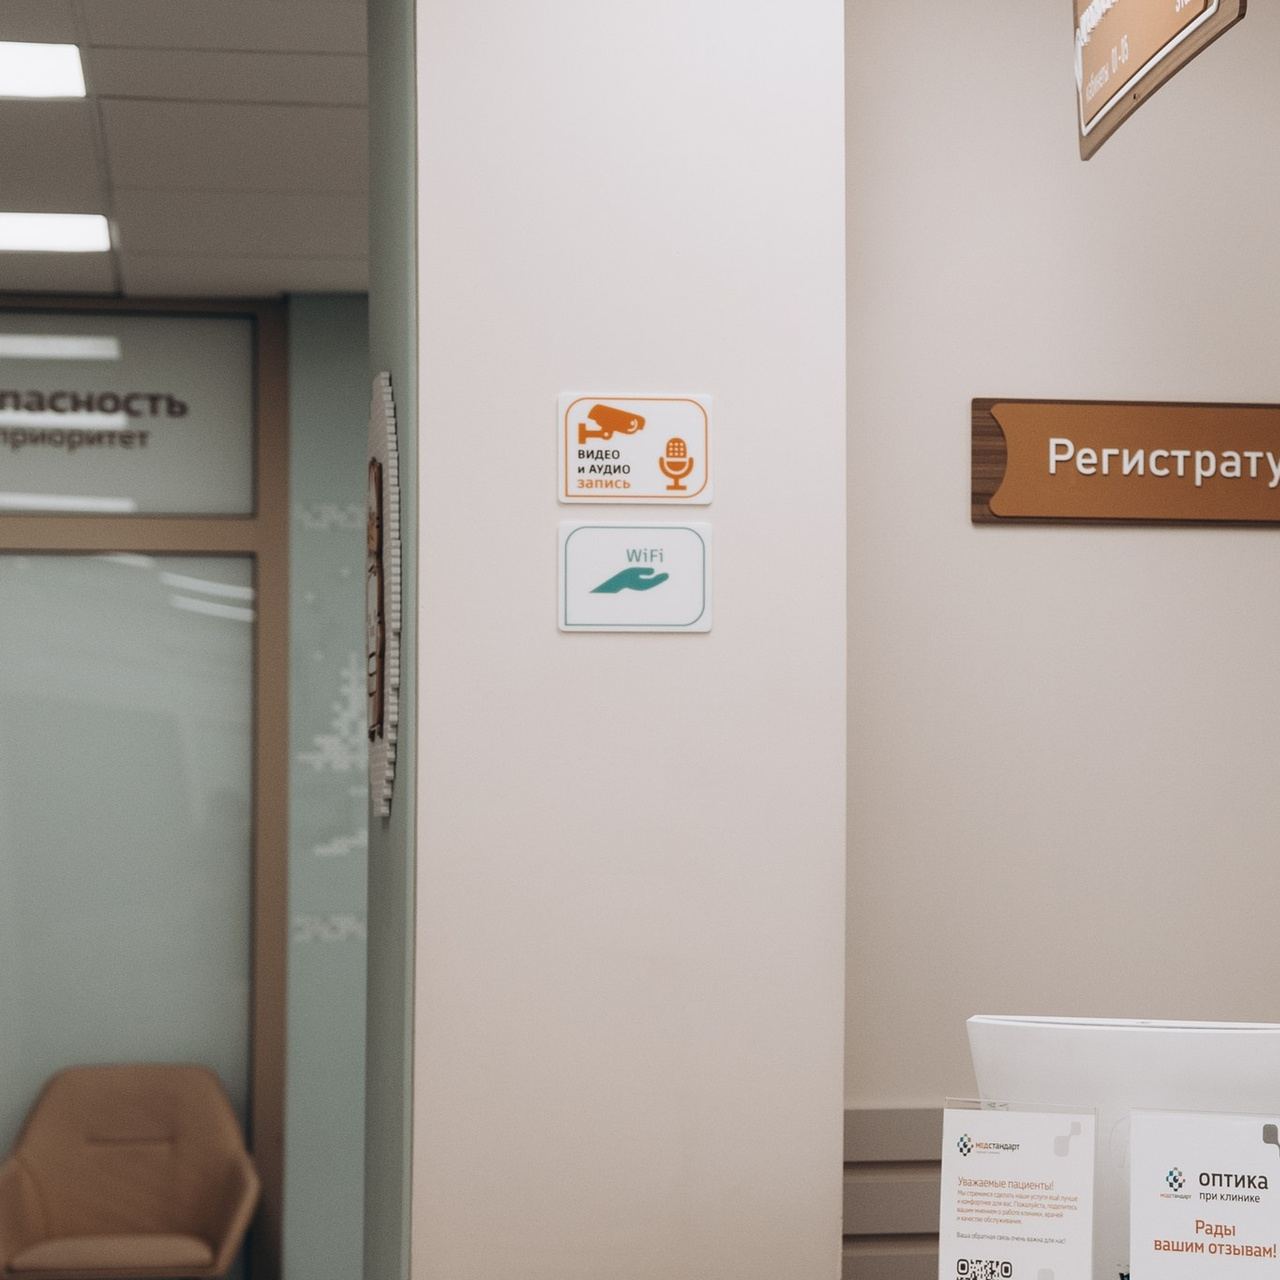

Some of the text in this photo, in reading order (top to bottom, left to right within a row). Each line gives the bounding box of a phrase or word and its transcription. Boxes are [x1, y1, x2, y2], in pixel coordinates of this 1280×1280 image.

[577, 449, 620, 461] ВИДЕО
[577, 464, 631, 475] и АУДИО
[577, 479, 631, 489] запись
[626, 548, 664, 563] WiFi
[958, 1176, 1054, 1191] Уважаемые пациенты!
[1198, 1172, 1269, 1190] оптика
[1199, 1192, 1217, 1202] при
[1219, 1192, 1261, 1203] клинике
[956, 1231, 971, 1239] Ваша
[1195, 1219, 1236, 1238] Рады
[1153, 1239, 1277, 1258] вашим отзывам!
